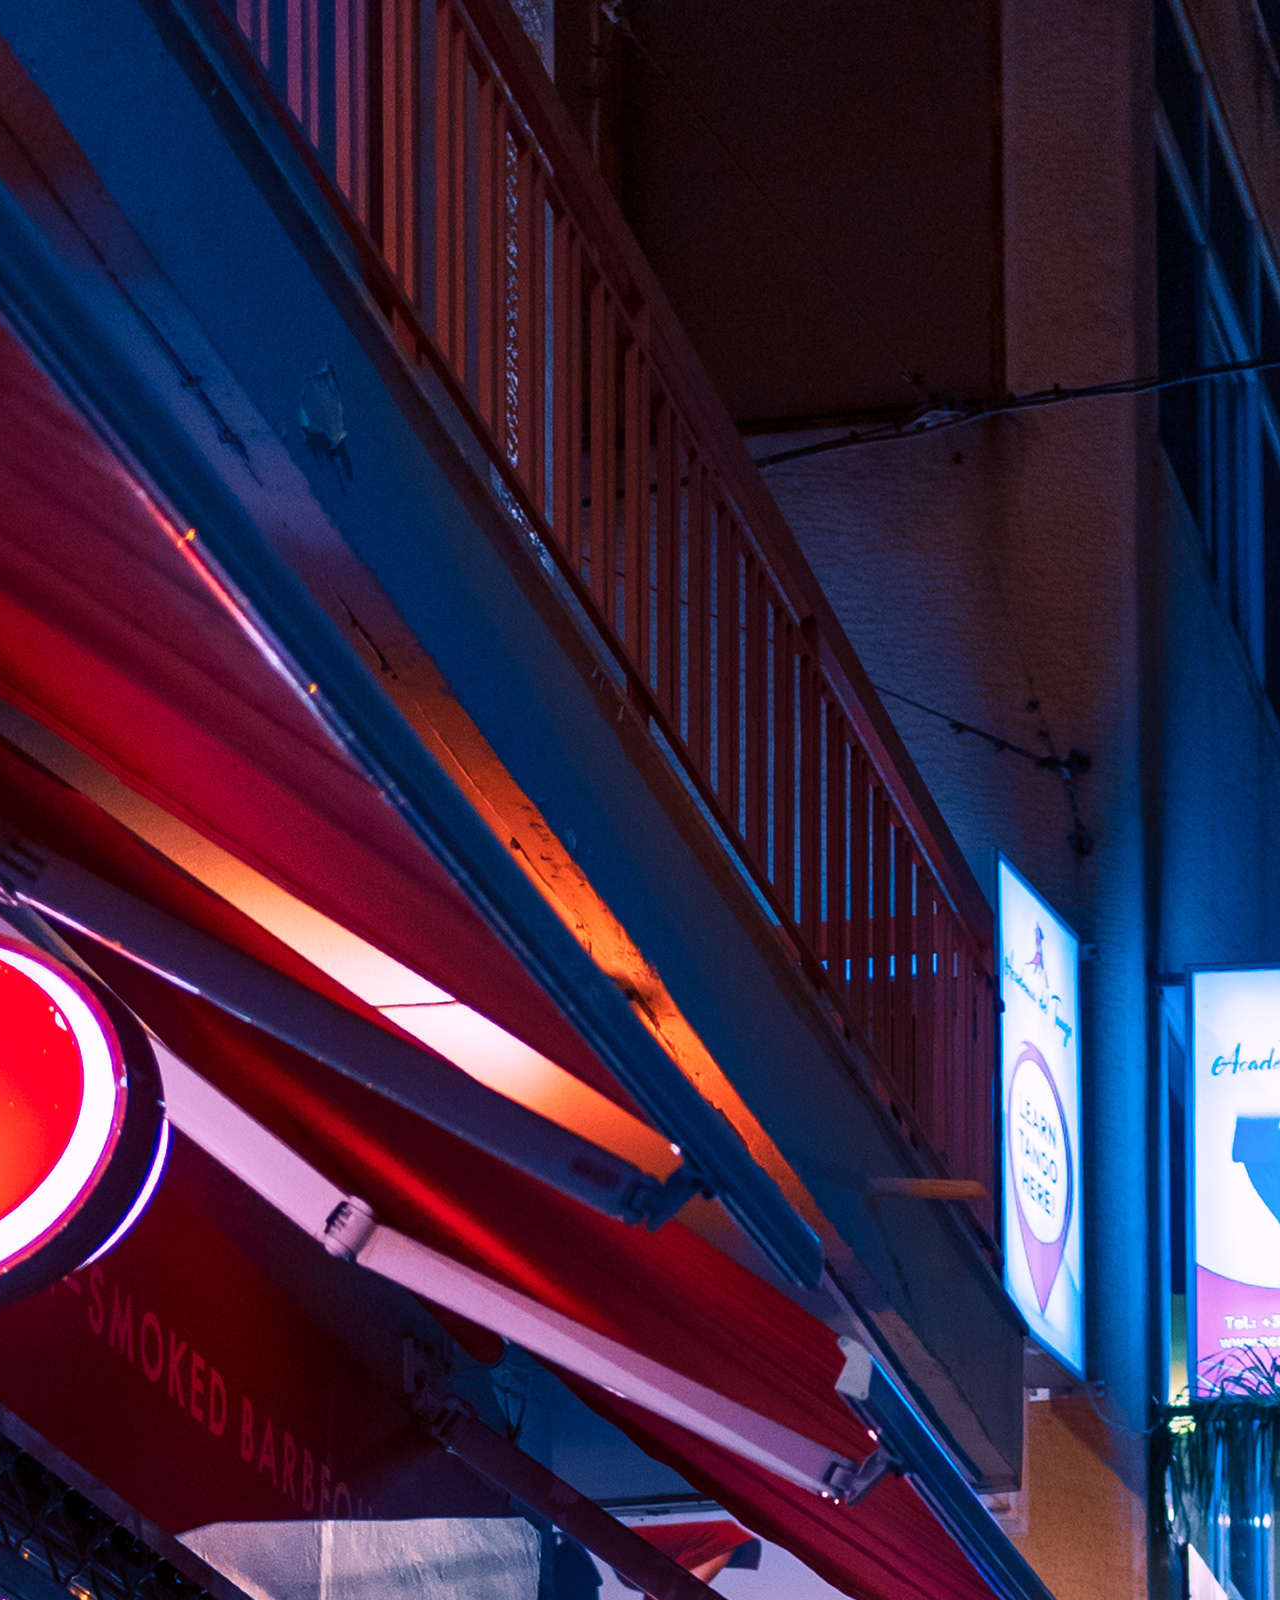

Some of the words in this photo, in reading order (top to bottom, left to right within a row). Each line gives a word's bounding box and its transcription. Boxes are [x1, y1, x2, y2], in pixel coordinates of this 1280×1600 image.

[1019, 1097, 1058, 1149] LEARN
[1018, 1126, 1058, 1184] TANGO
[1021, 1166, 1056, 1219] HERE!
